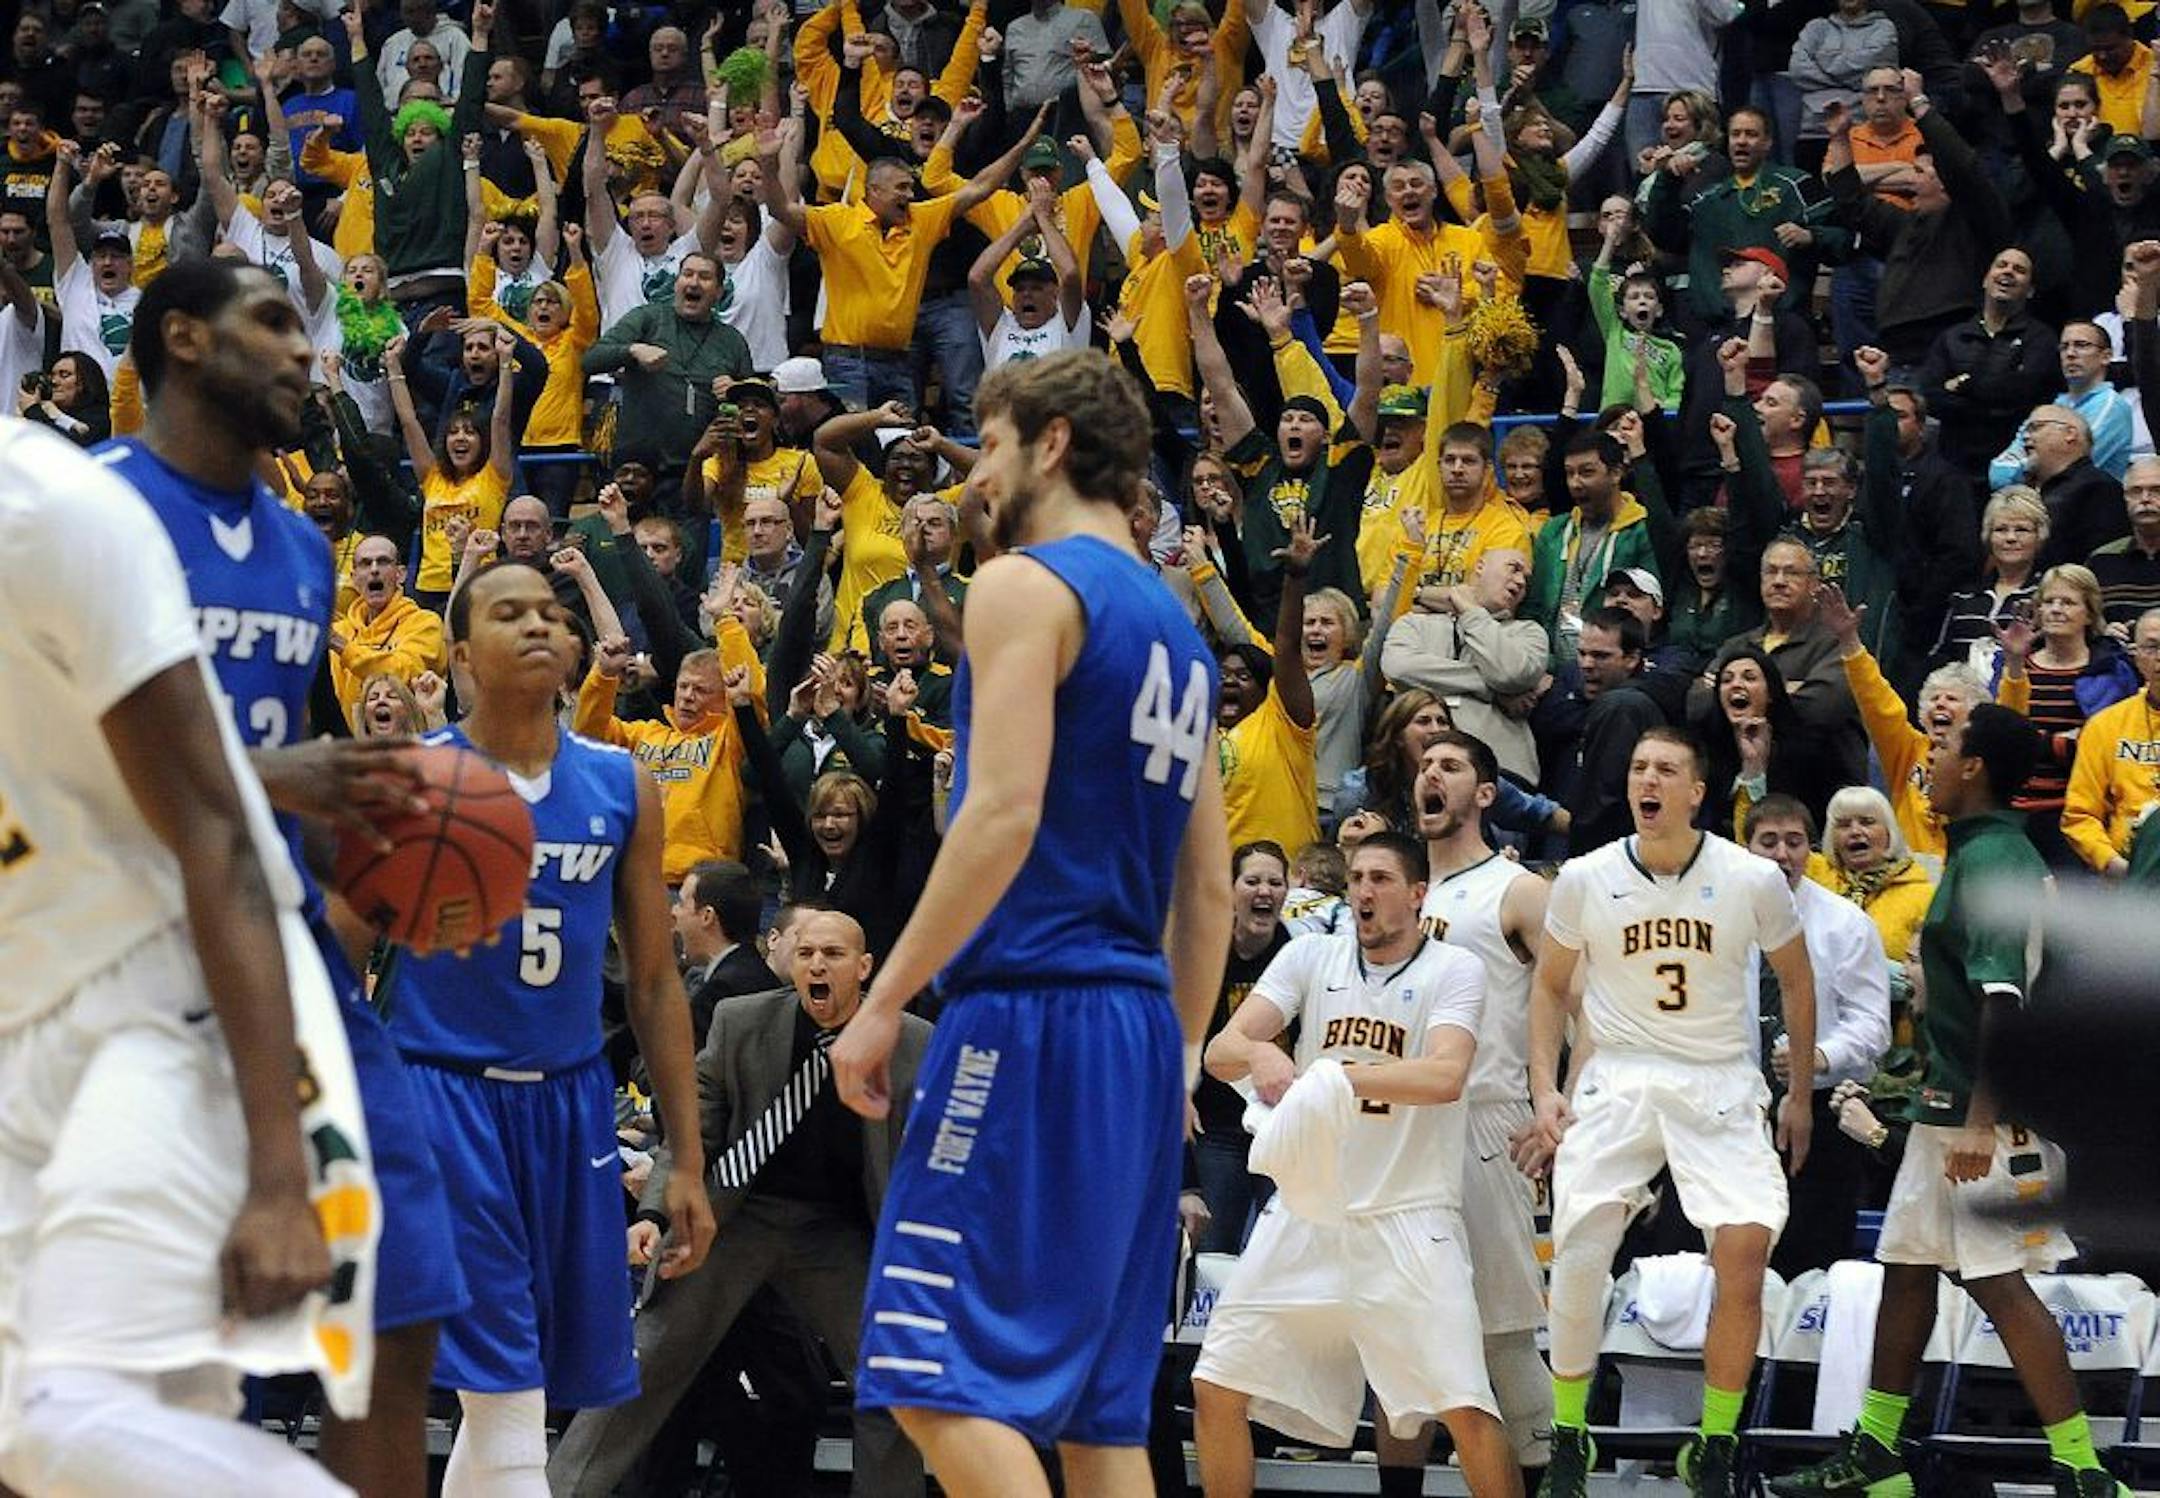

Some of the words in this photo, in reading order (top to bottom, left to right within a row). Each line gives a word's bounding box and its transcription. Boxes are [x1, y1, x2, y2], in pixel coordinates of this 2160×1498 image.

[1130, 640, 1210, 801] 44
[519, 907, 563, 987] 5
[1622, 917, 1713, 957] BISON
[1655, 963, 1688, 1012] 3
[1322, 1015, 1406, 1060] BISON
[944, 1044, 1000, 1118] WAYNE
[927, 1117, 978, 1175] FORT
